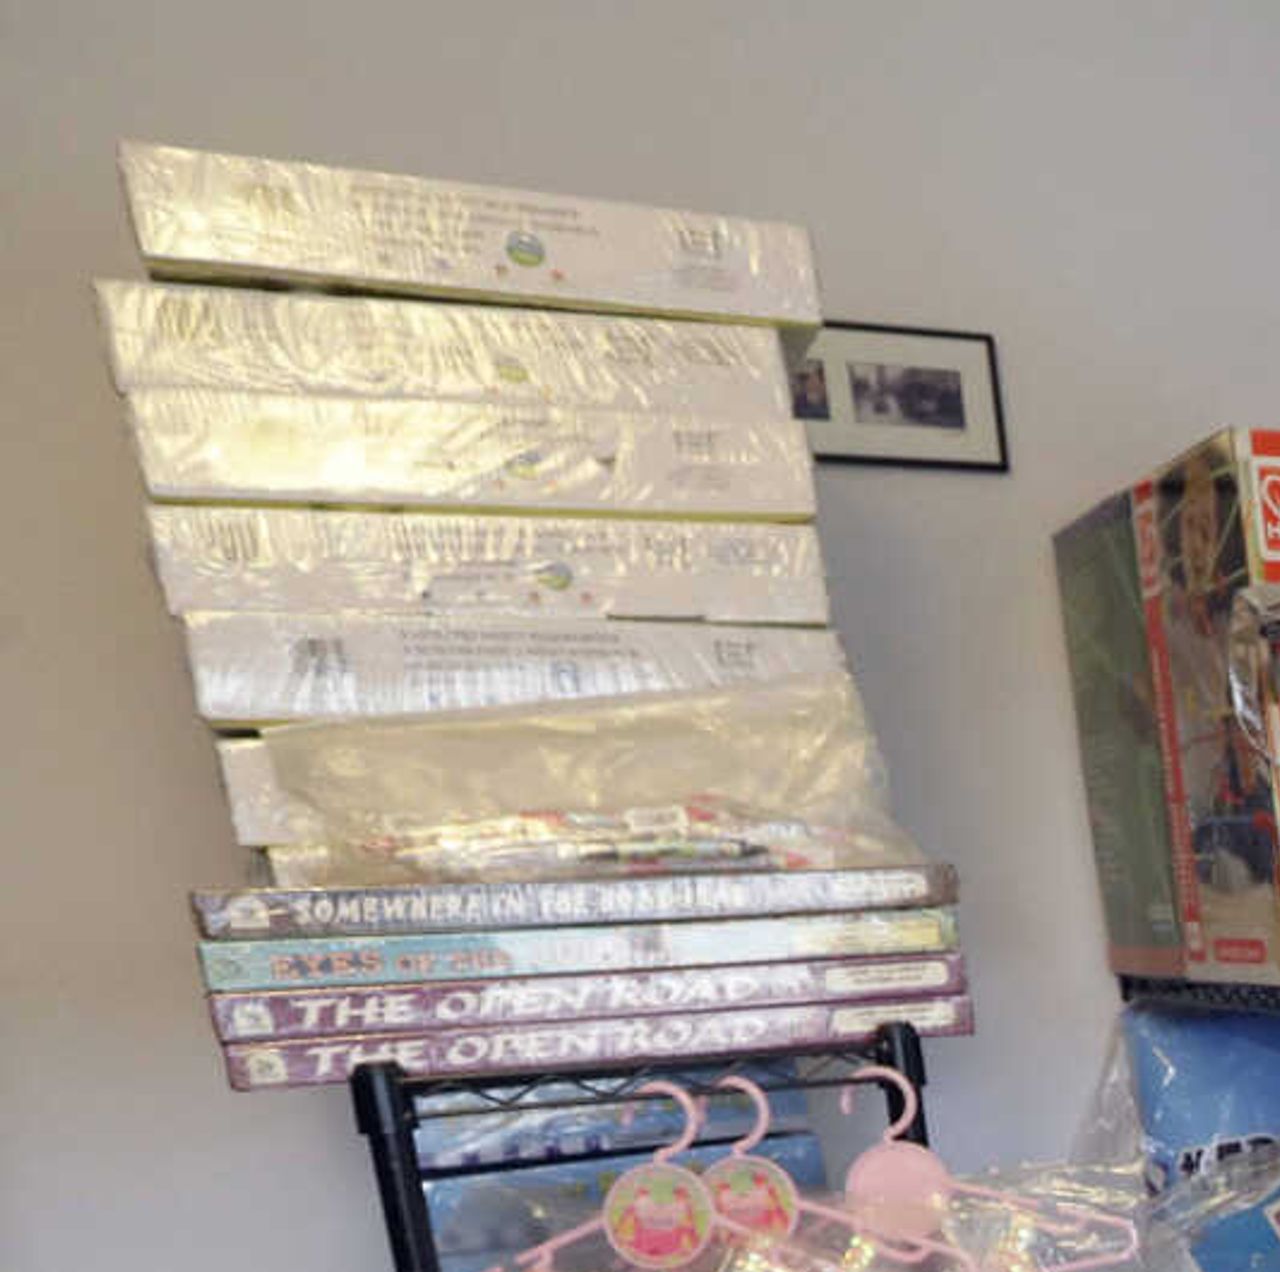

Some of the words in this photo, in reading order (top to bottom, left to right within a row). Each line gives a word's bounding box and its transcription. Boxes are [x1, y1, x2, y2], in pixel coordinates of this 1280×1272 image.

[270, 949, 384, 981] EYES
[292, 992, 420, 1030] THE
[436, 979, 596, 1014] OPEN
[607, 975, 760, 1008] ROAD
[304, 1038, 430, 1078] THE
[445, 1028, 608, 1066] OPEN
[618, 1016, 769, 1051] ROAD
